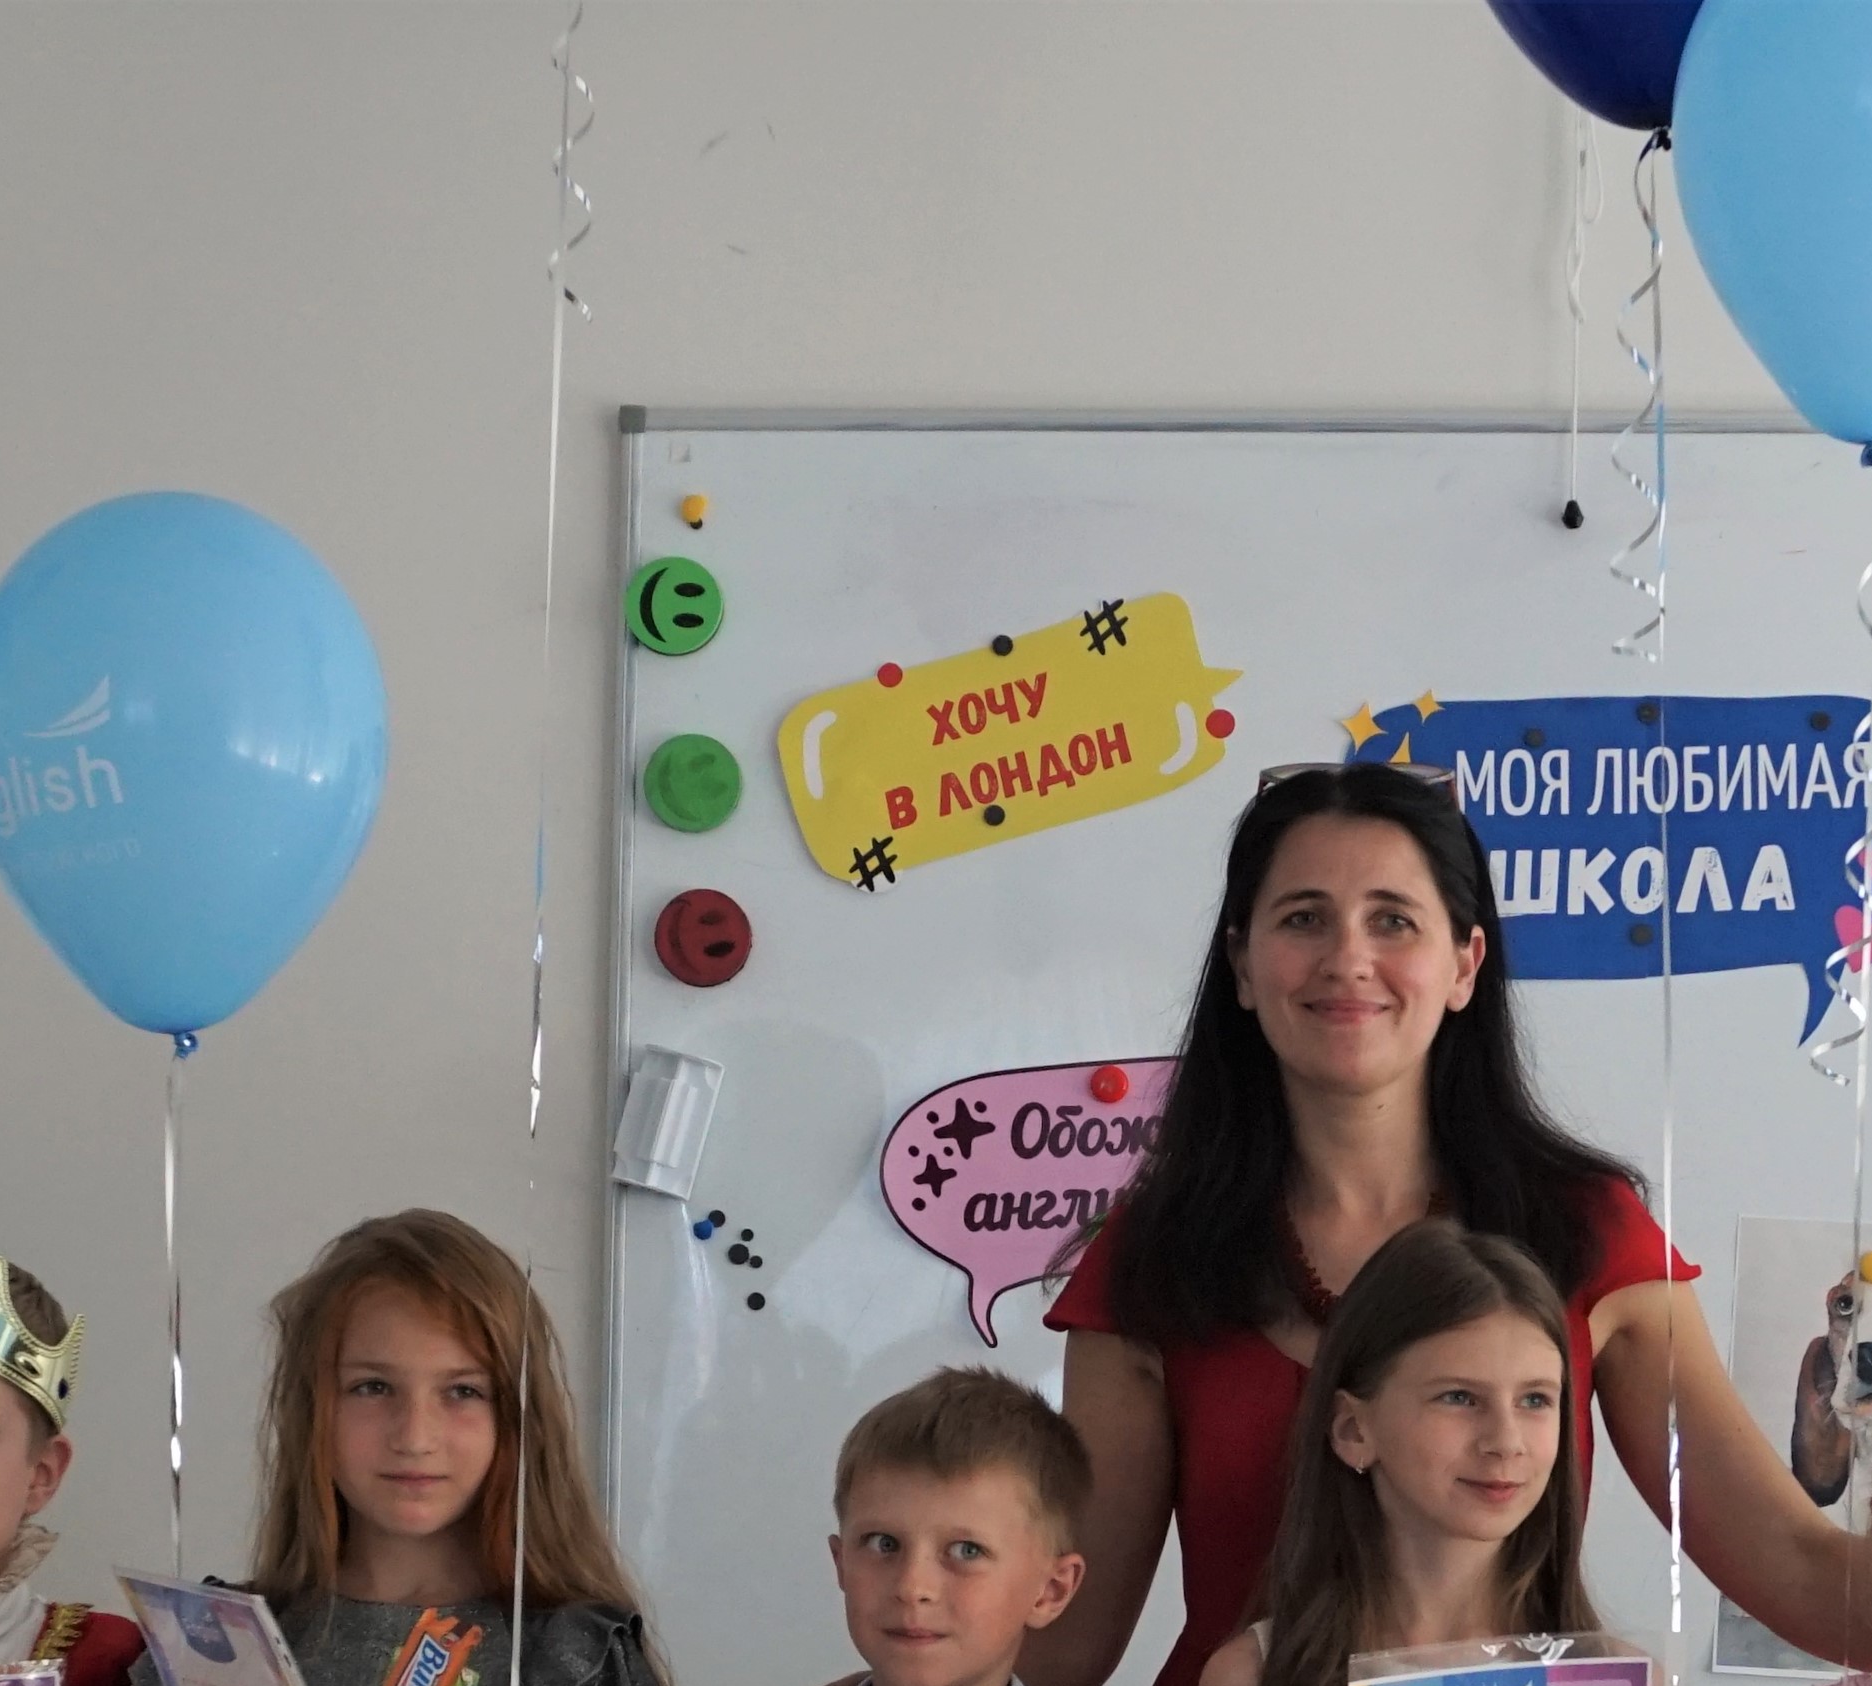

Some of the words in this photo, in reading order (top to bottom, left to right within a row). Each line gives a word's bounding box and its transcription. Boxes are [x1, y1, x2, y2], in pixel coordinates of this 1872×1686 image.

[926, 672, 1048, 746] ХОЧУ
[885, 786, 918, 830] В
[939, 722, 1132, 817] ЛОНДОН
[1456, 748, 1570, 816] МОЯ
[1587, 742, 1872, 815] ЛЮБИМАЯ
[1489, 845, 1796, 918] ШКОЛА
[1011, 1102, 1165, 1159] Обож
